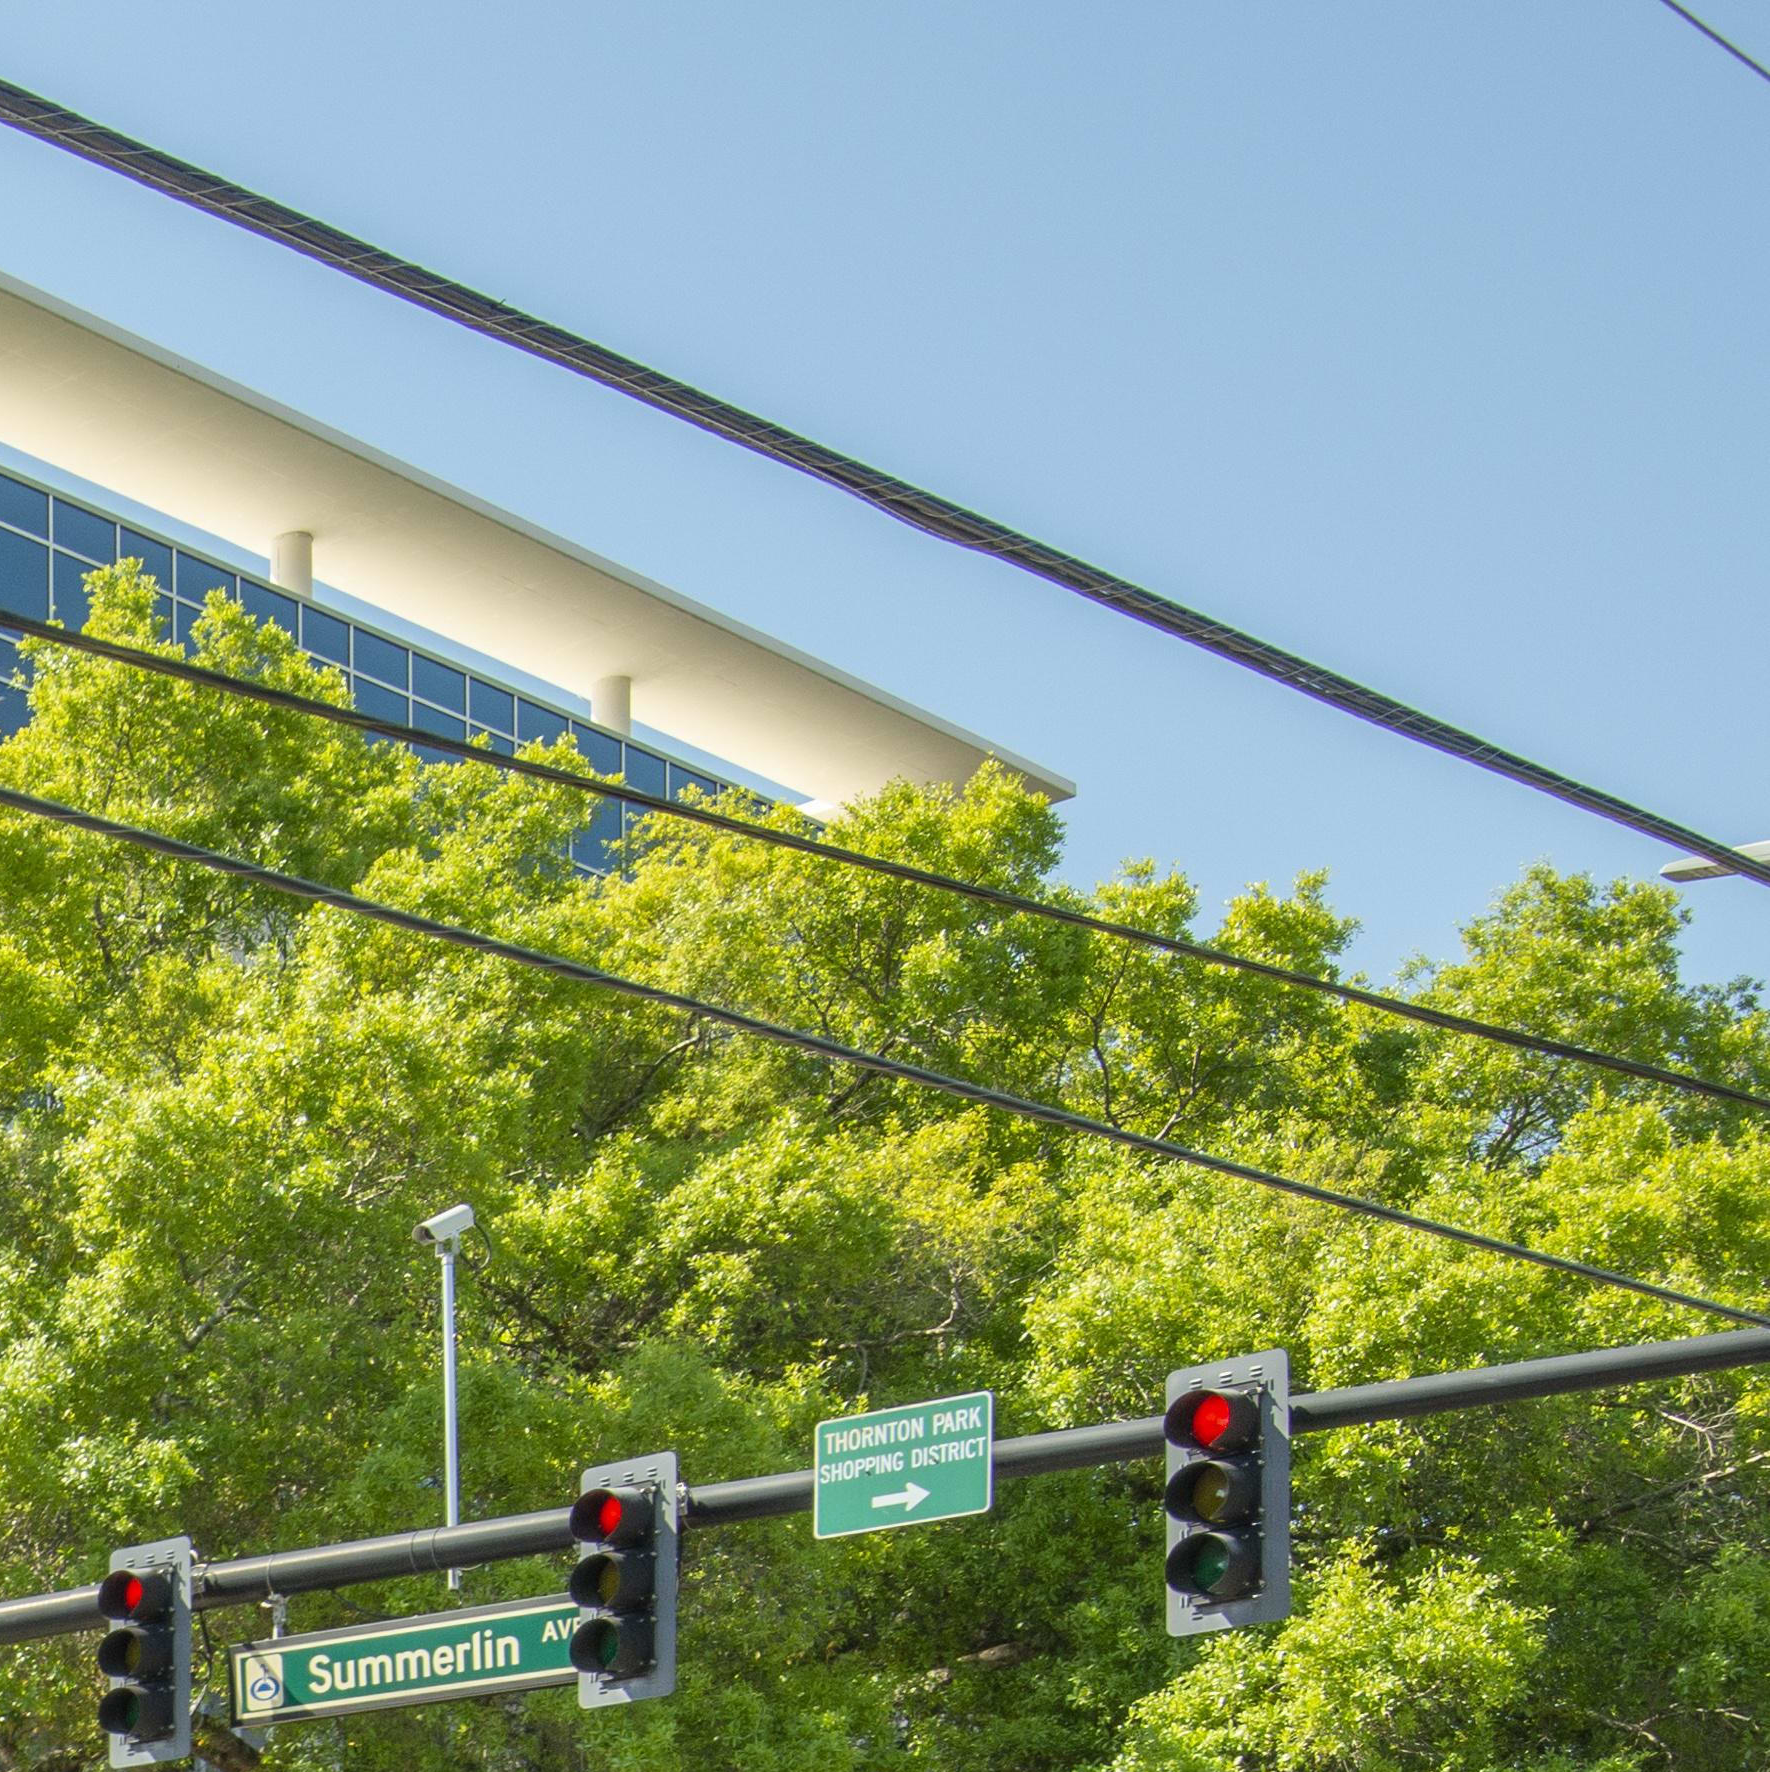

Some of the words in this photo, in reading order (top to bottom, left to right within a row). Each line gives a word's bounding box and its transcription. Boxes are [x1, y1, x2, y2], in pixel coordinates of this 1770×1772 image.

[824, 1416, 925, 1455] THORNTON
[932, 1406, 982, 1436] PARK
[820, 1451, 904, 1485] SHOPPING
[911, 1436, 987, 1469] DISTRICT
[308, 1629, 520, 1694] Summerlin
